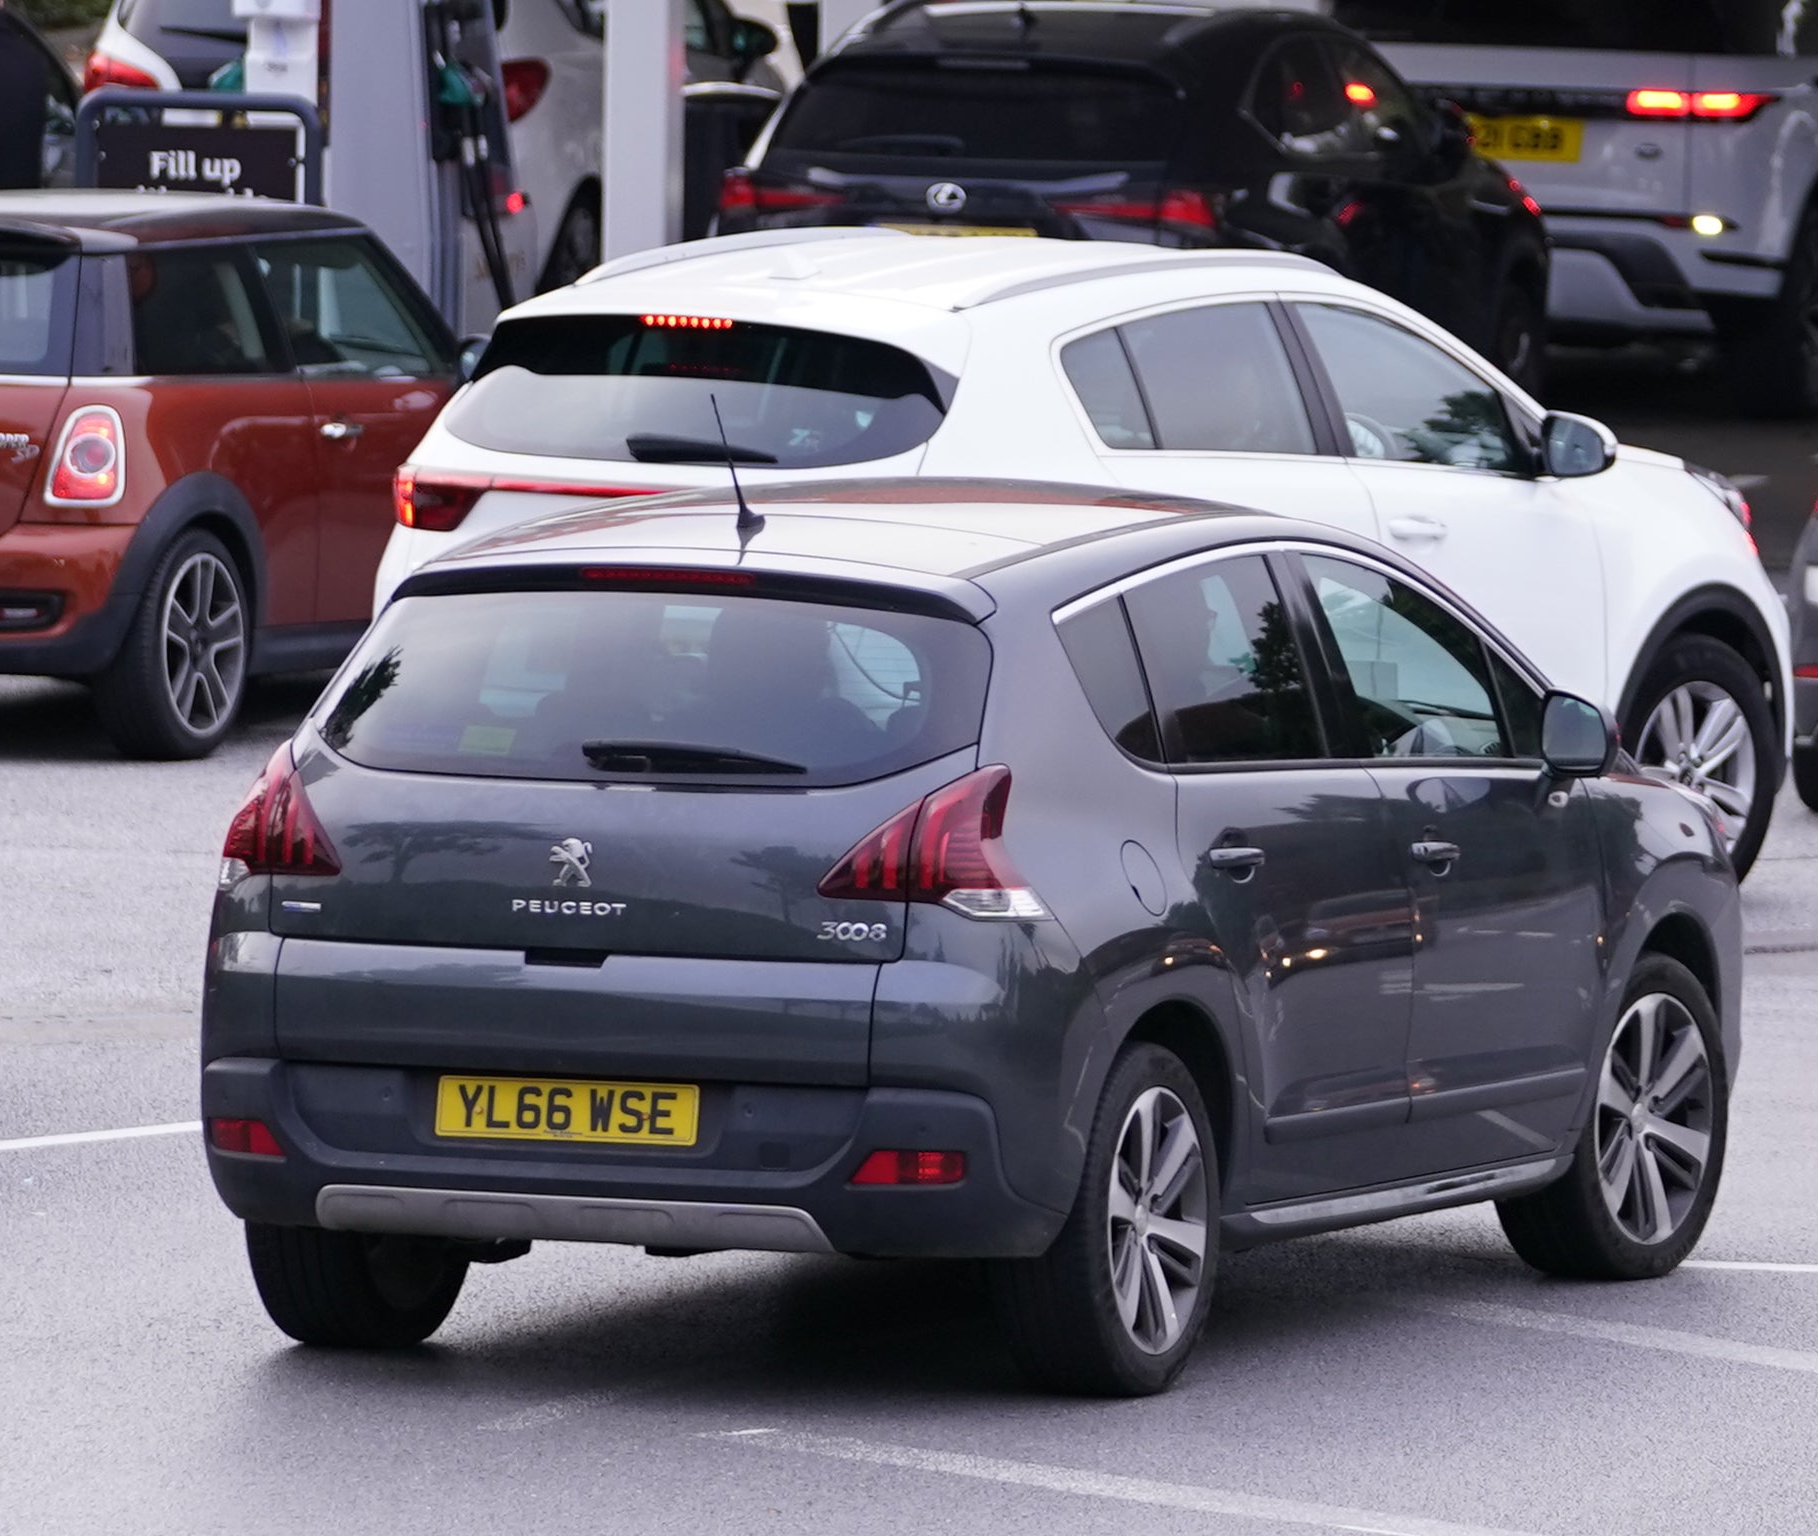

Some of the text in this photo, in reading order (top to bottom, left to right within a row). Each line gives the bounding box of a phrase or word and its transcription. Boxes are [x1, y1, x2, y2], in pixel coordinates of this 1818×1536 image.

[149, 149, 243, 187] Fill up
[511, 899, 628, 917] PEUGEOT
[816, 920, 889, 942] 3008
[458, 1084, 678, 1136] YL66 WSE
